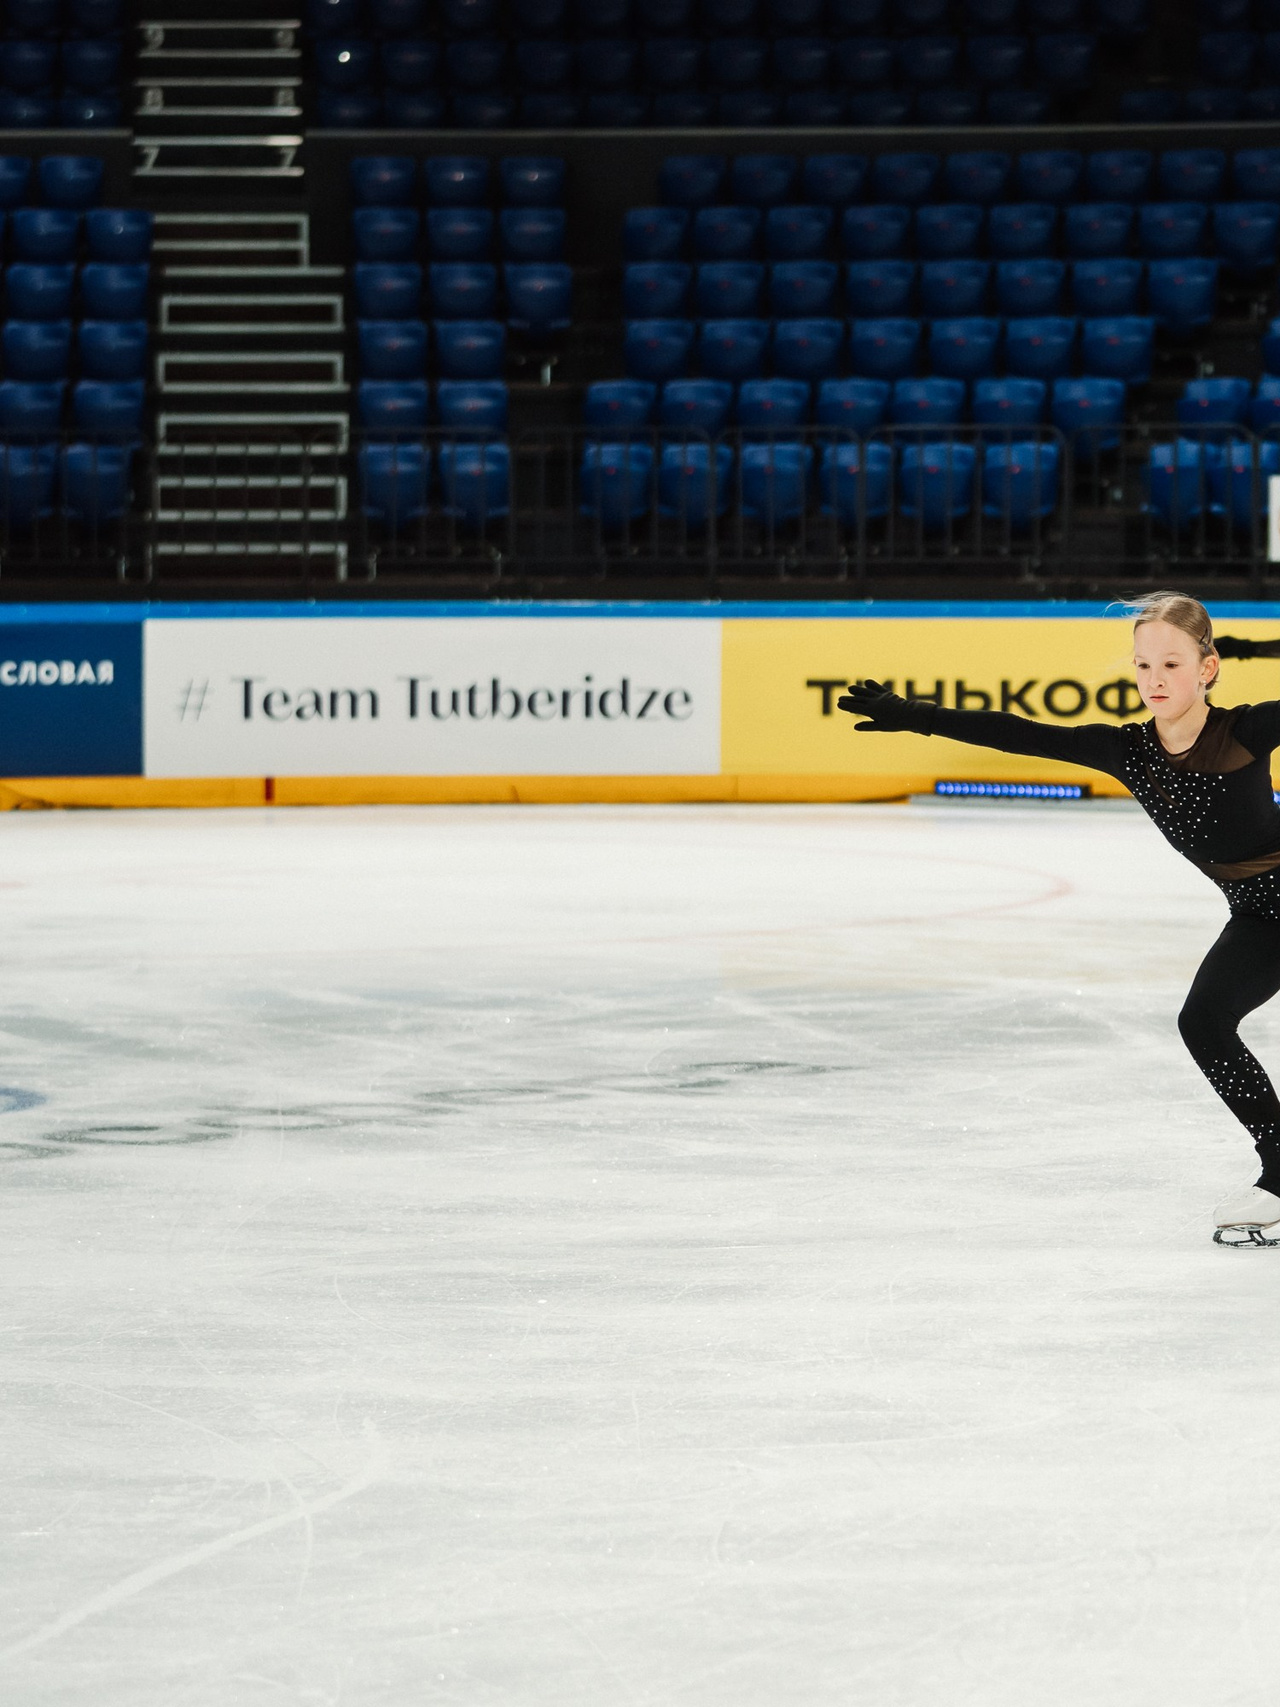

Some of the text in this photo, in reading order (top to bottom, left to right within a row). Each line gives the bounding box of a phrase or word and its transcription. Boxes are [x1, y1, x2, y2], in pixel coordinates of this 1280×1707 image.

[141, 144, 161, 172] 7
[279, 145, 297, 170] 7
[0, 659, 114, 687] СЛОВАЯ
[175, 674, 694, 723] # Team Tutberidze
